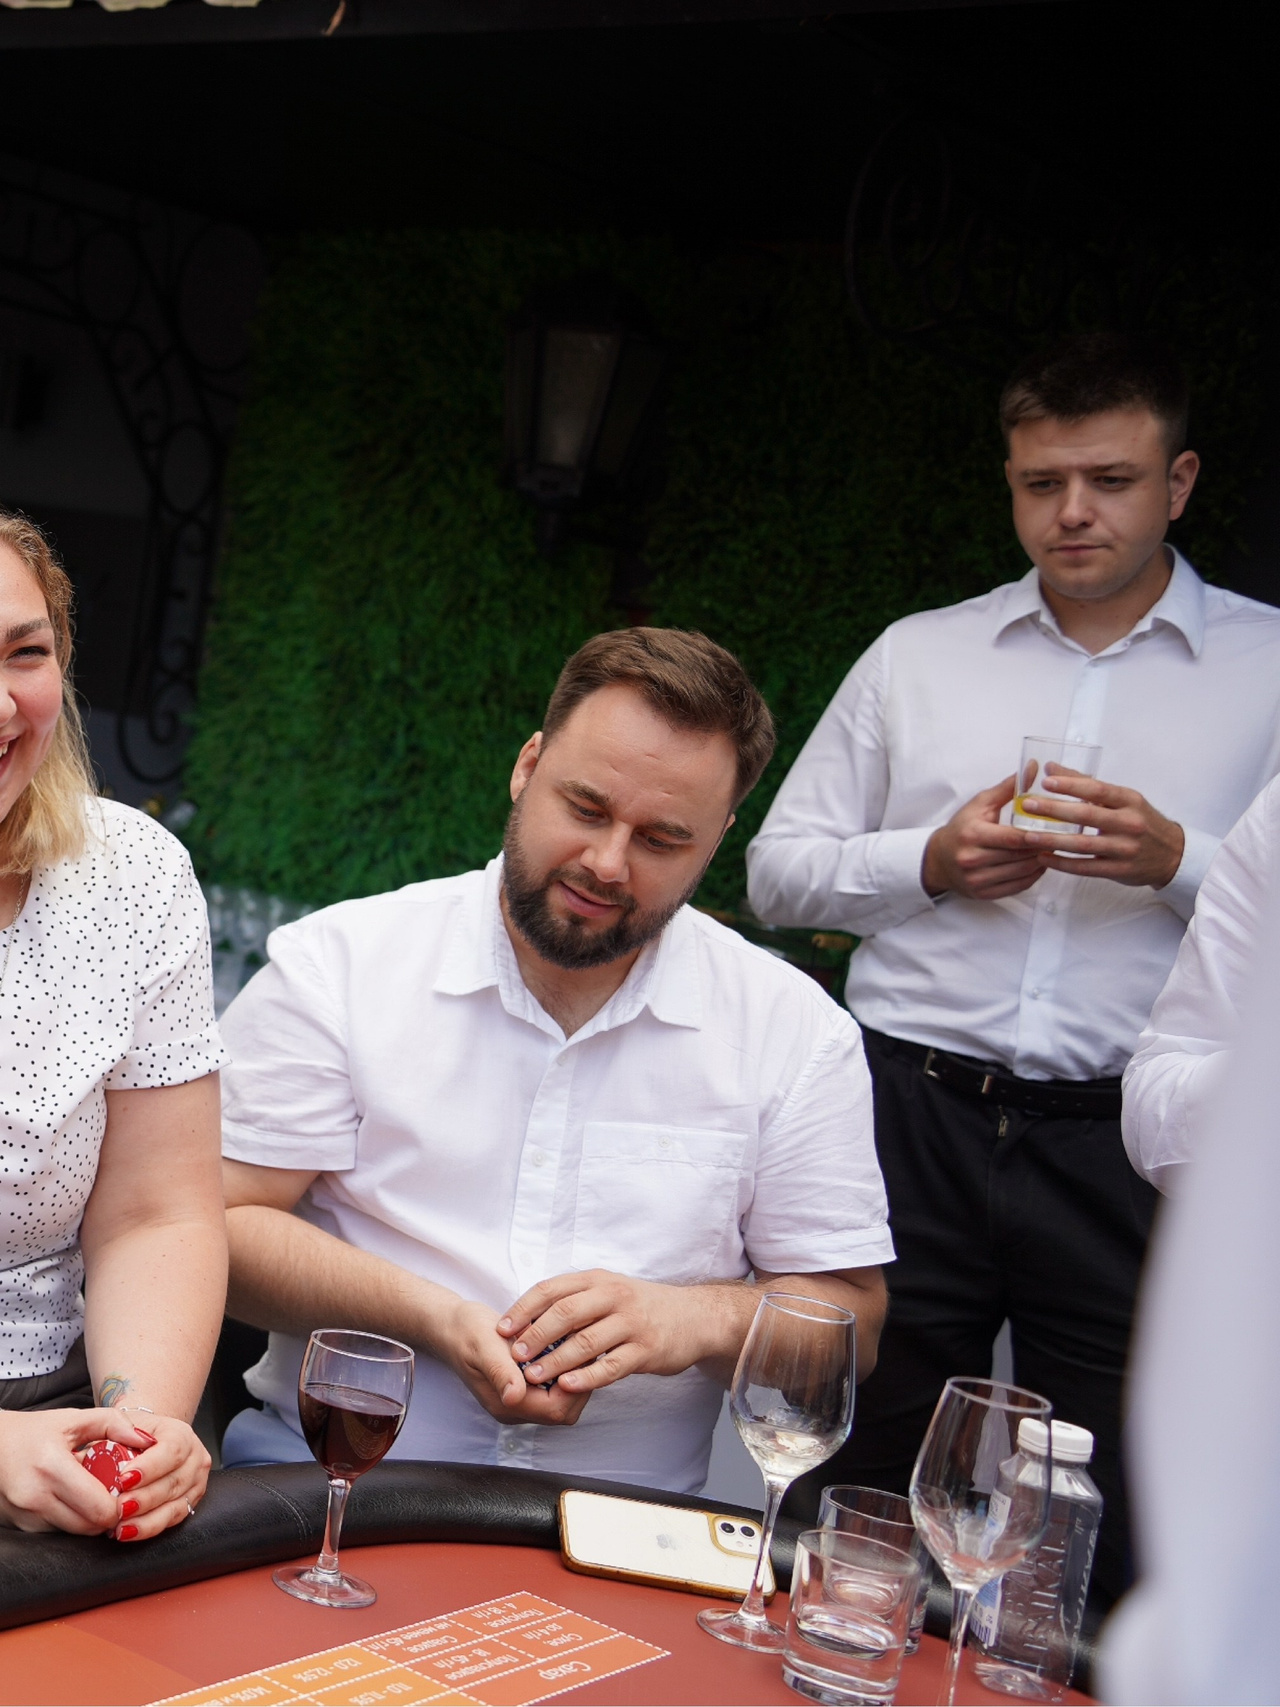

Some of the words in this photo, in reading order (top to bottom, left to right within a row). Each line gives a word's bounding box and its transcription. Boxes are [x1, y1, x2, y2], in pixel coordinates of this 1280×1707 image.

[400, 1626, 437, 1640] менее
[543, 1633, 583, 1646] Сухое,
[385, 1637, 404, 1646] 45
[402, 1635, 458, 1653] Сладкое,
[471, 1648, 491, 1657] 18
[333, 1657, 362, 1670] 12,0
[451, 1655, 469, 1664] 45
[292, 1666, 333, 1683] 12,5%
[538, 1661, 591, 1680] Сахар
